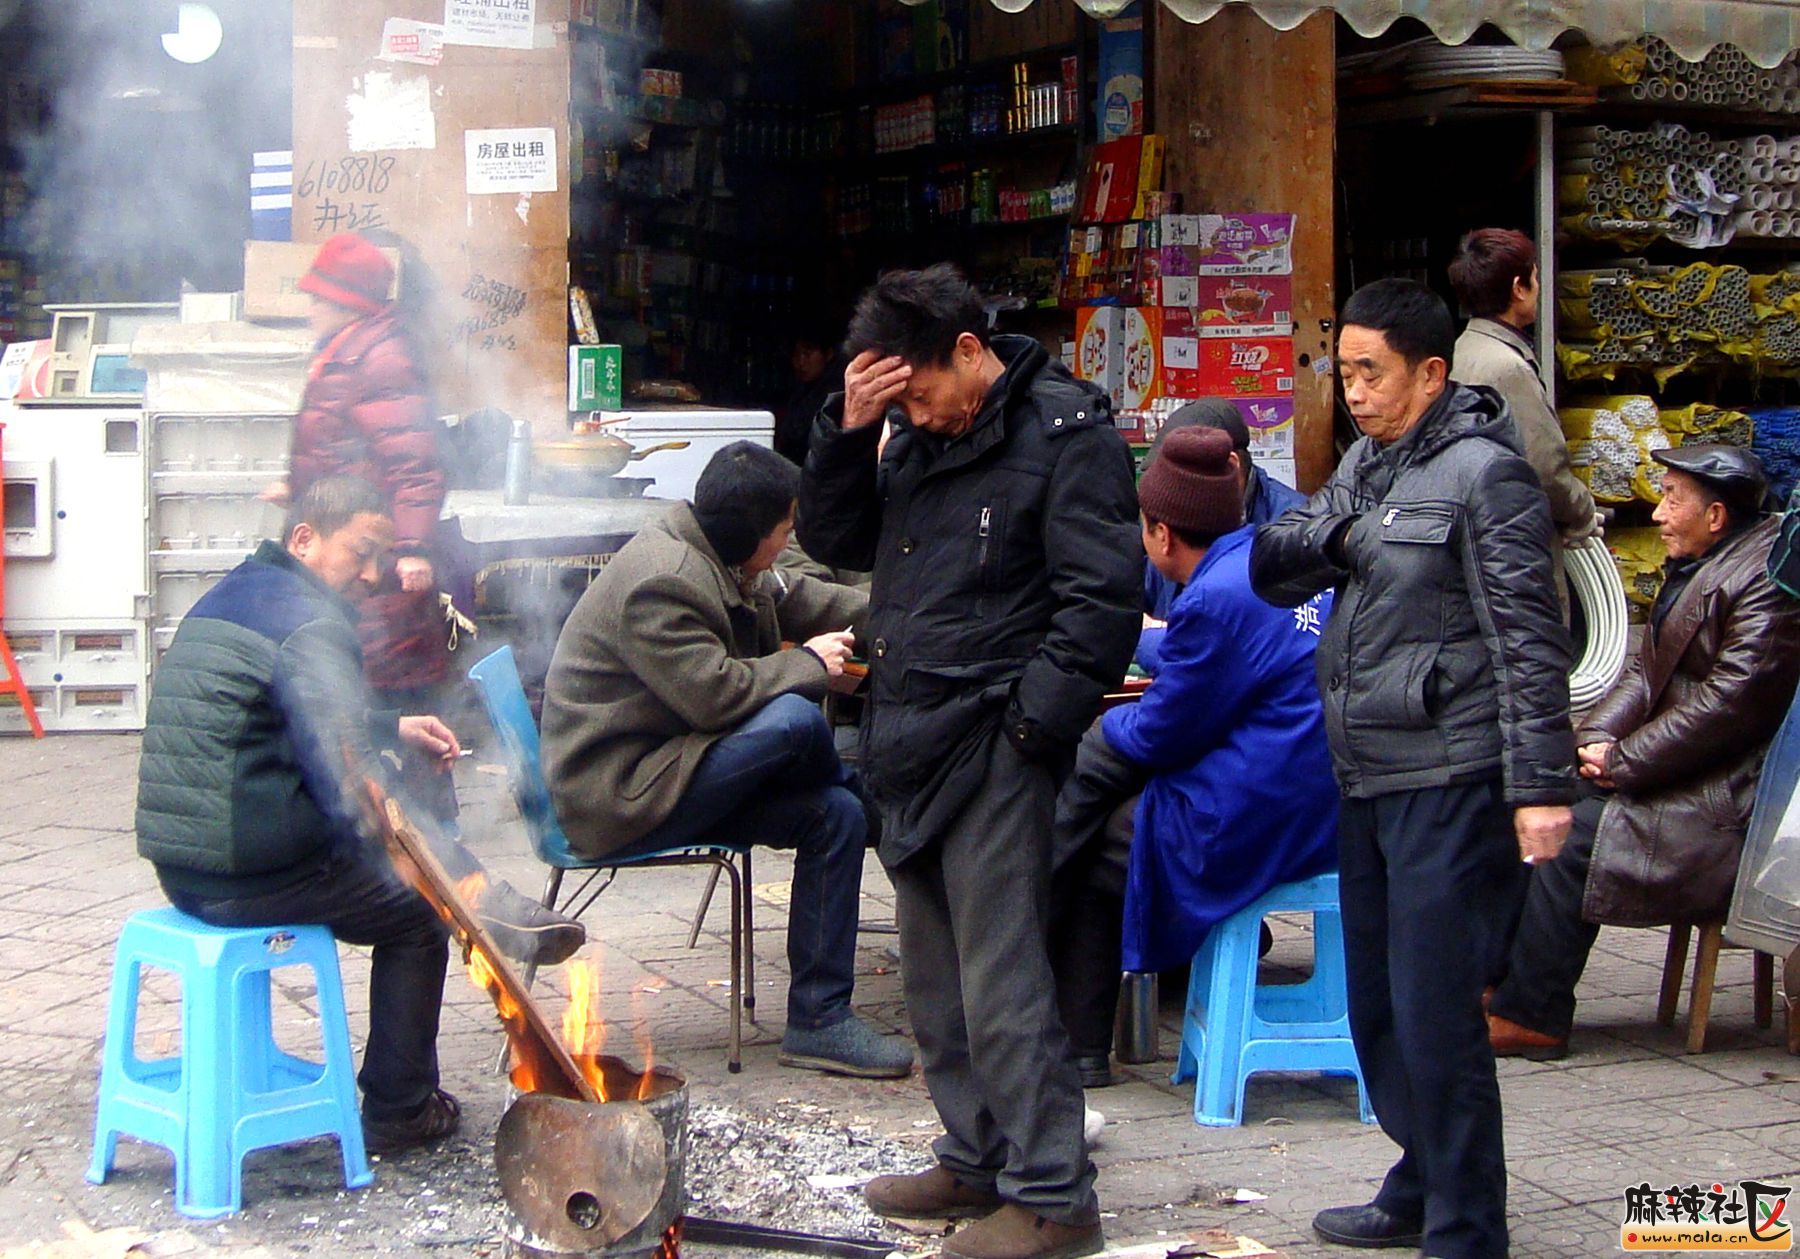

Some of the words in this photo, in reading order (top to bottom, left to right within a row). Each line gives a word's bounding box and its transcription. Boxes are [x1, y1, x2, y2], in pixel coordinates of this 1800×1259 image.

[477, 141, 544, 159] 房屋出租
[297, 152, 396, 198] 6108818
